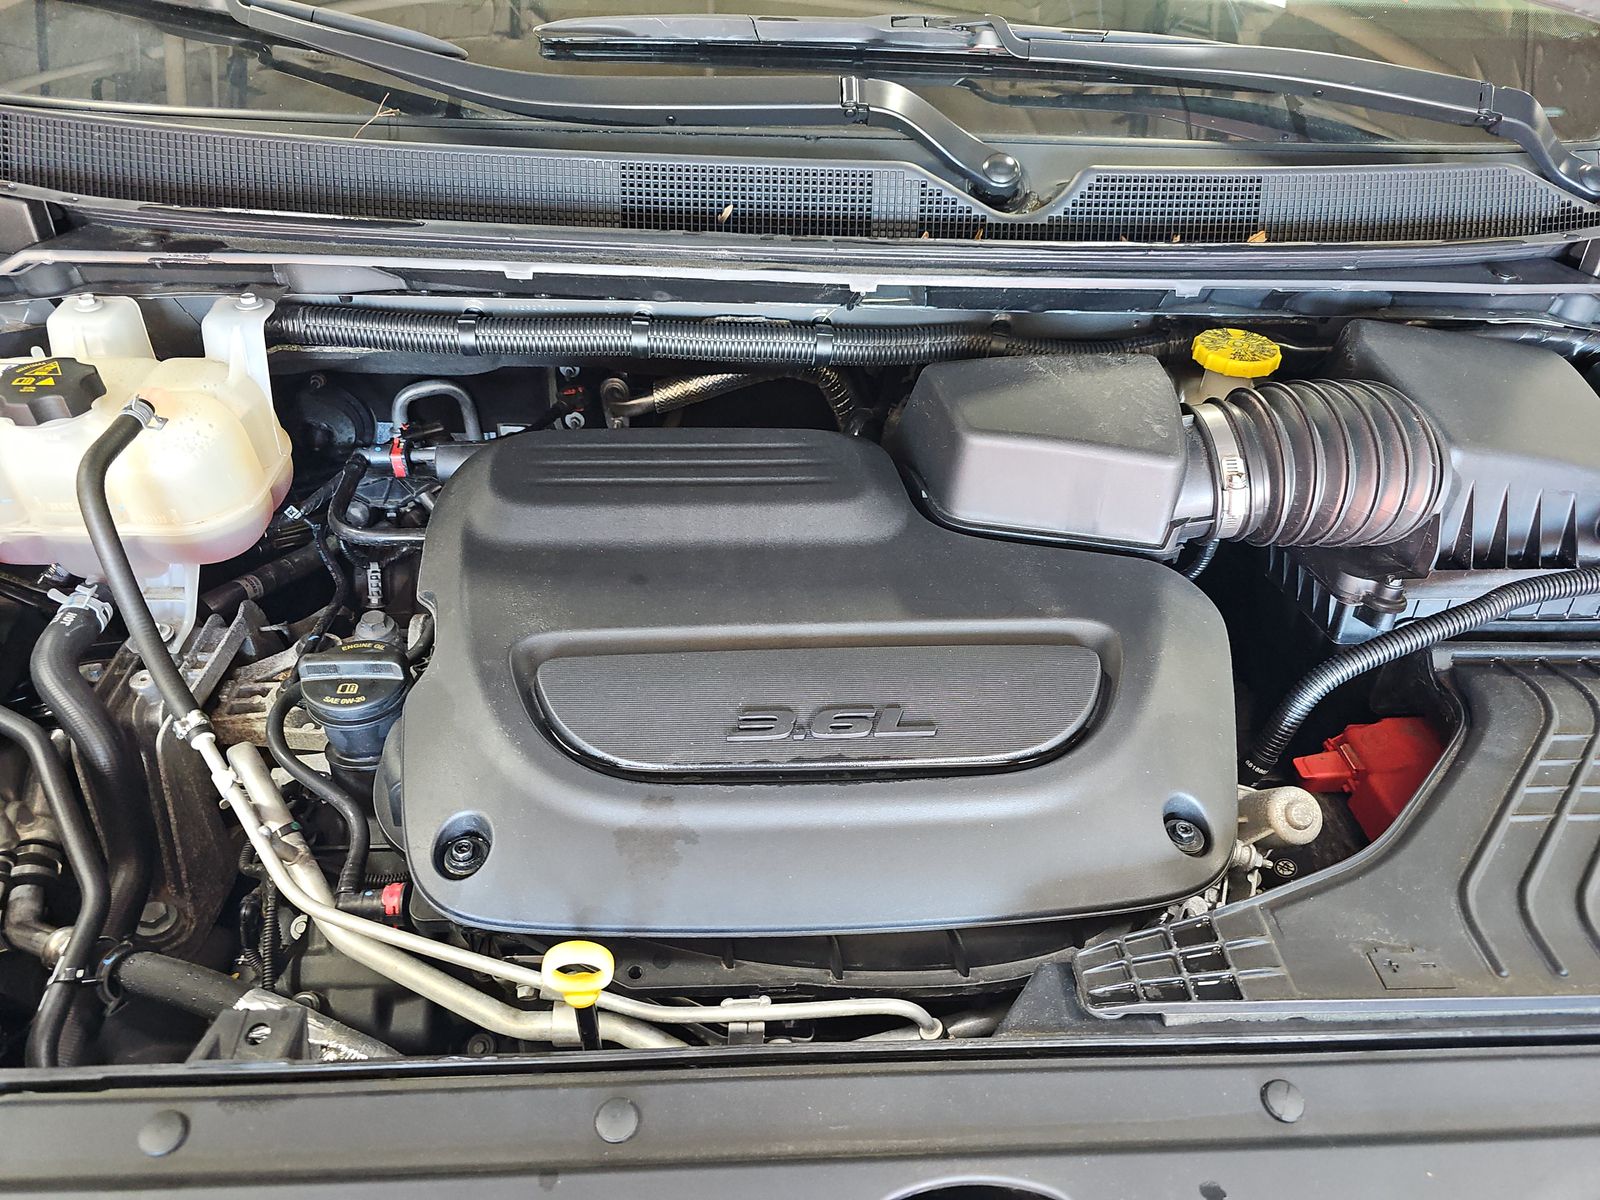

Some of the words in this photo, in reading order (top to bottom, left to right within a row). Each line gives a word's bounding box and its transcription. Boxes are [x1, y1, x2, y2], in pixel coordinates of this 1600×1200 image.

[341, 643, 373, 651] ENGINE
[322, 696, 340, 704] SAE
[340, 696, 366, 704] 0W-20
[726, 704, 938, 742] 3.6L
